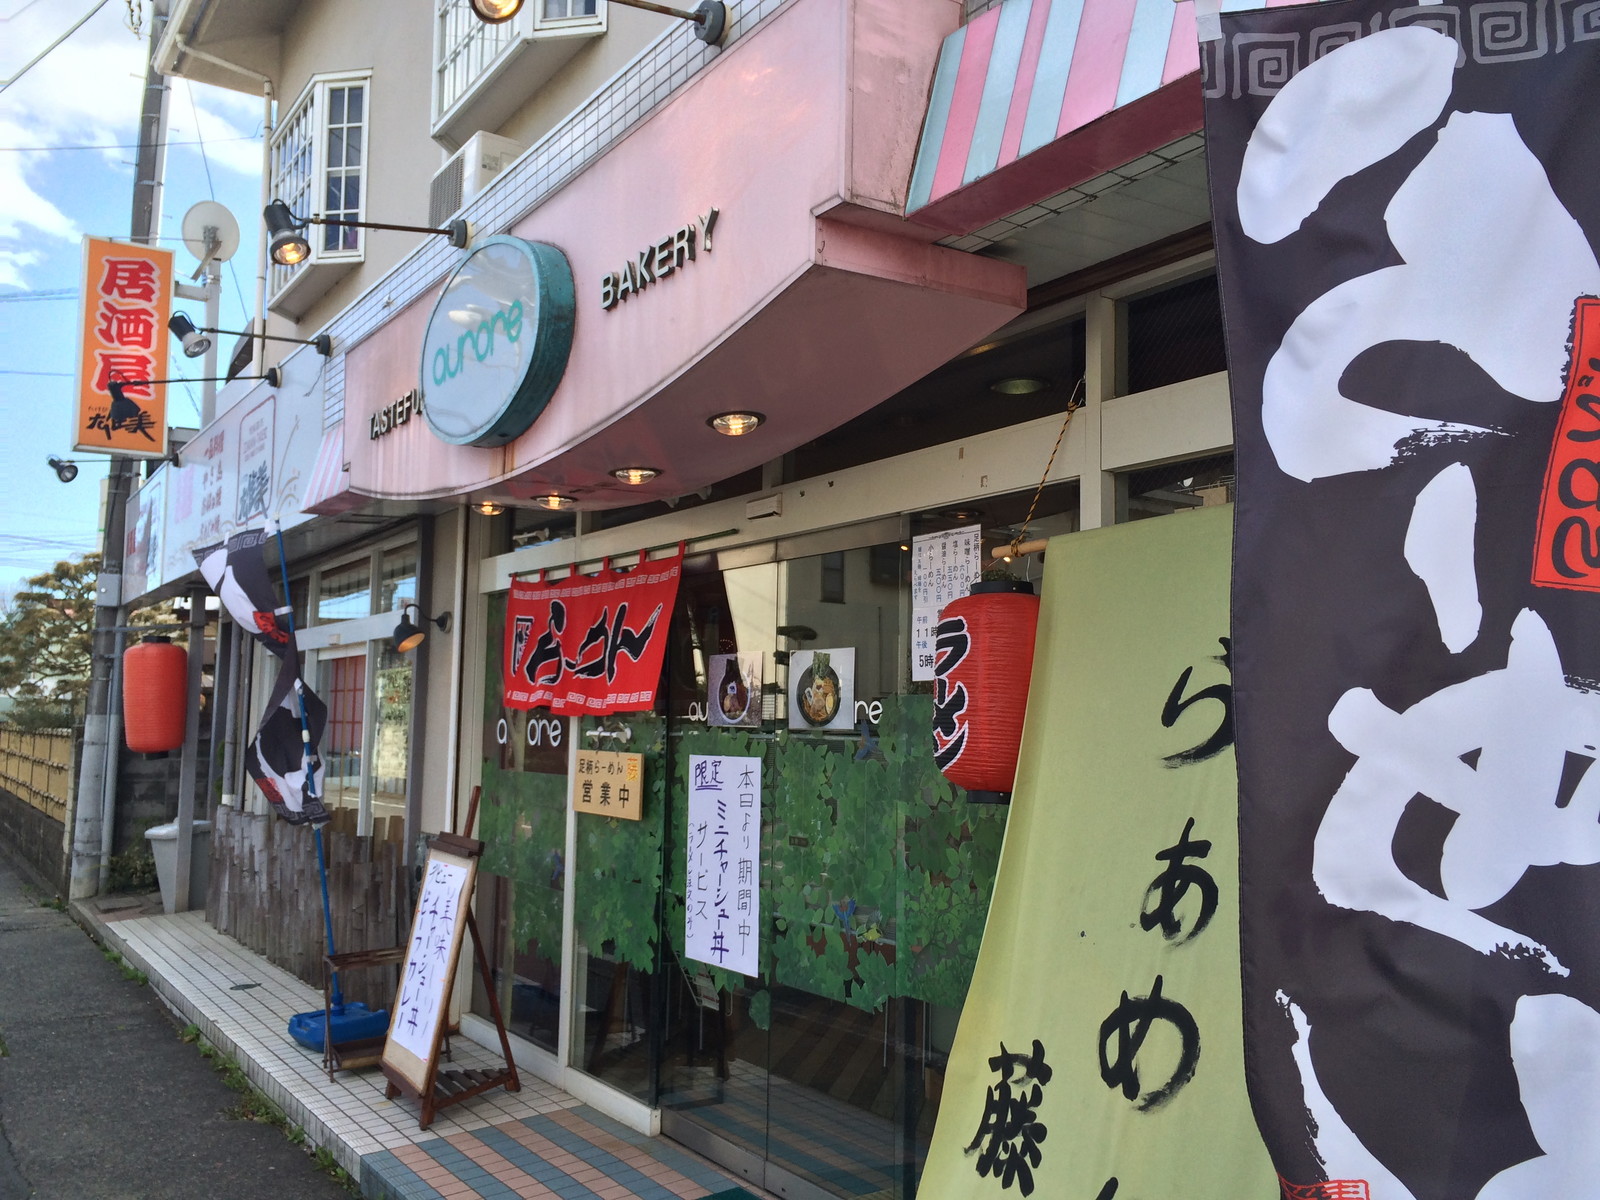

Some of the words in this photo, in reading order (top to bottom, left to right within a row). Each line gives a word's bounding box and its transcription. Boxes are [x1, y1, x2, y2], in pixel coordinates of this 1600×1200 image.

[601, 207, 719, 311] BAKERY
[96, 256, 157, 399] 居酒屋
[582, 779, 630, 809] 営業中
[695, 760, 724, 786] 限定
[695, 820, 709, 921] サービス
[1098, 637, 1236, 1200] らあめ
